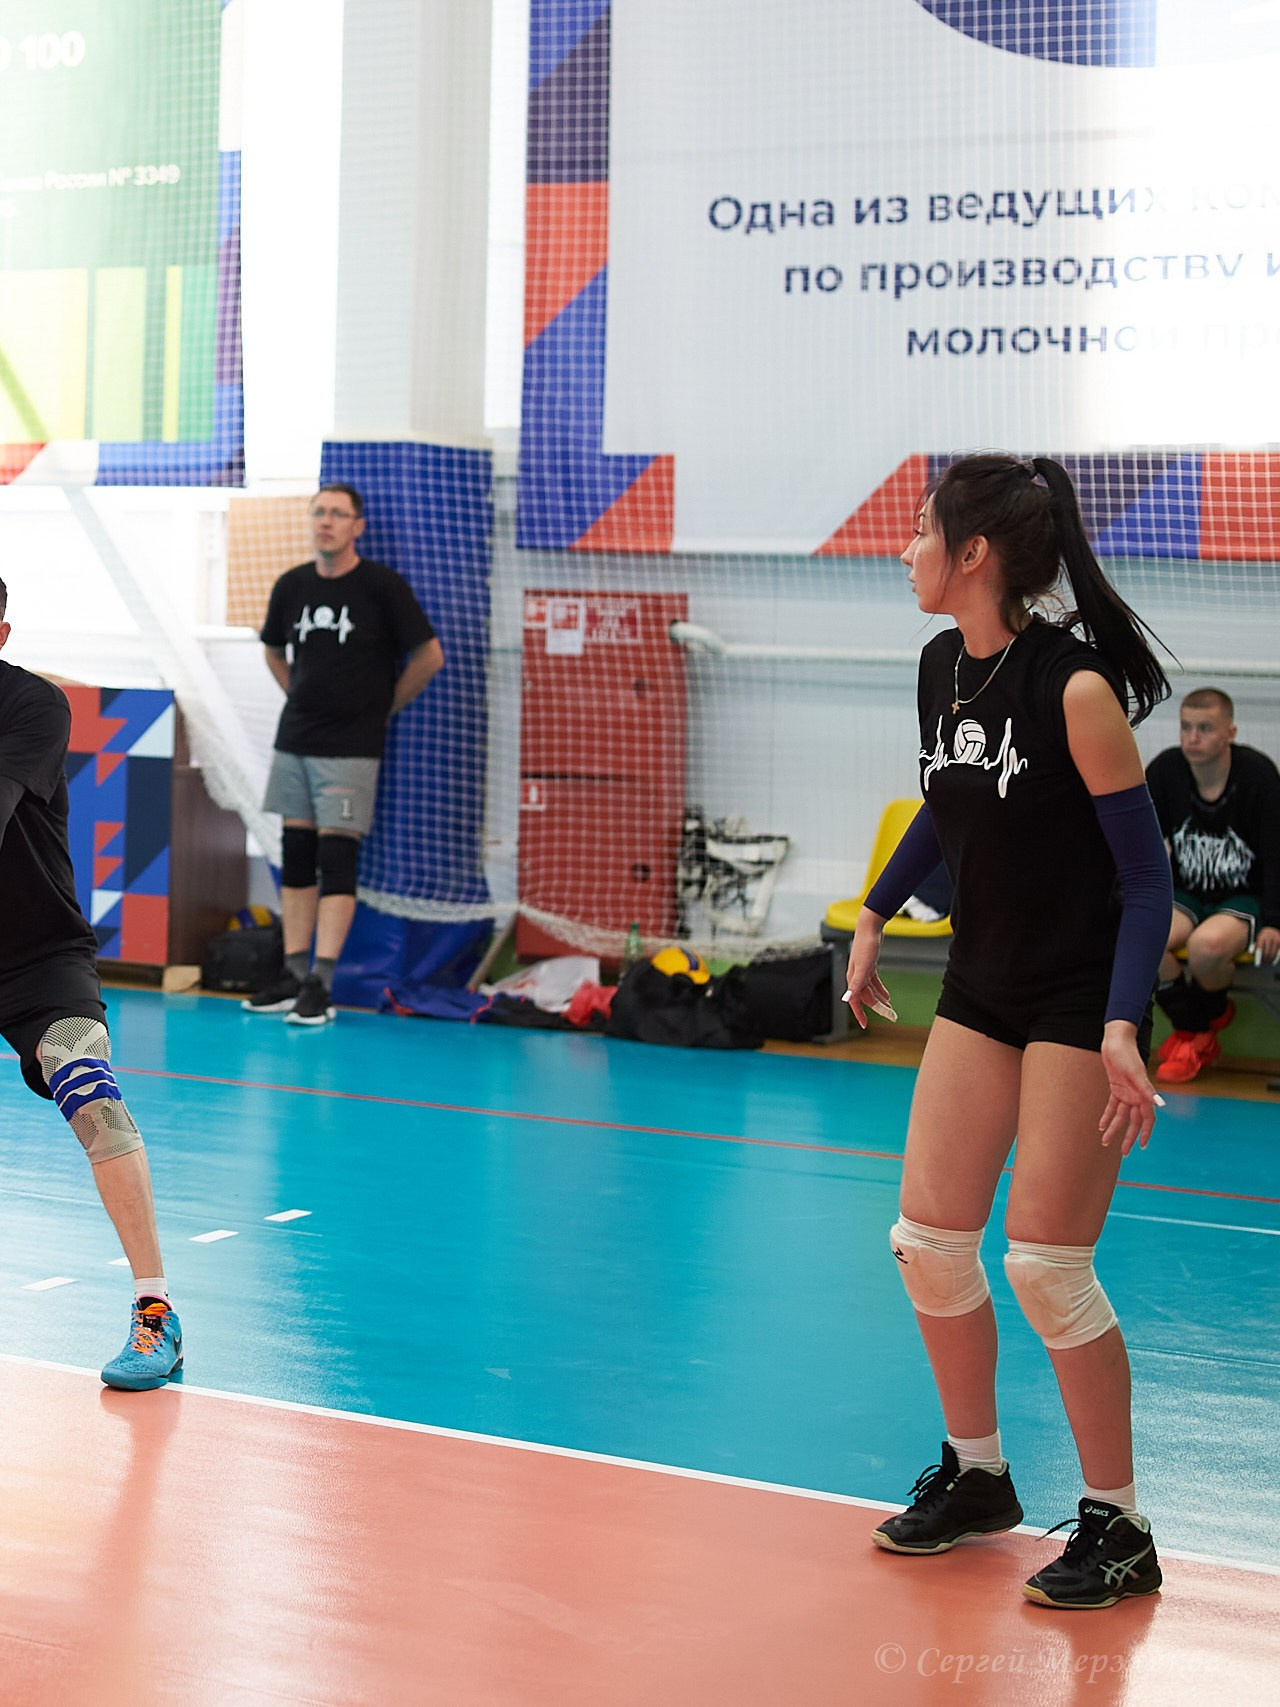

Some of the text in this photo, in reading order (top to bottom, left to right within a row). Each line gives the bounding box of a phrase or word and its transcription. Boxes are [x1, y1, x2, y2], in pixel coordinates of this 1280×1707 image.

[19, 31, 86, 70] 100
[708, 194, 835, 236] Одна
[855, 192, 909, 225] из
[784, 262, 843, 294] по
[861, 251, 1245, 299] производству
